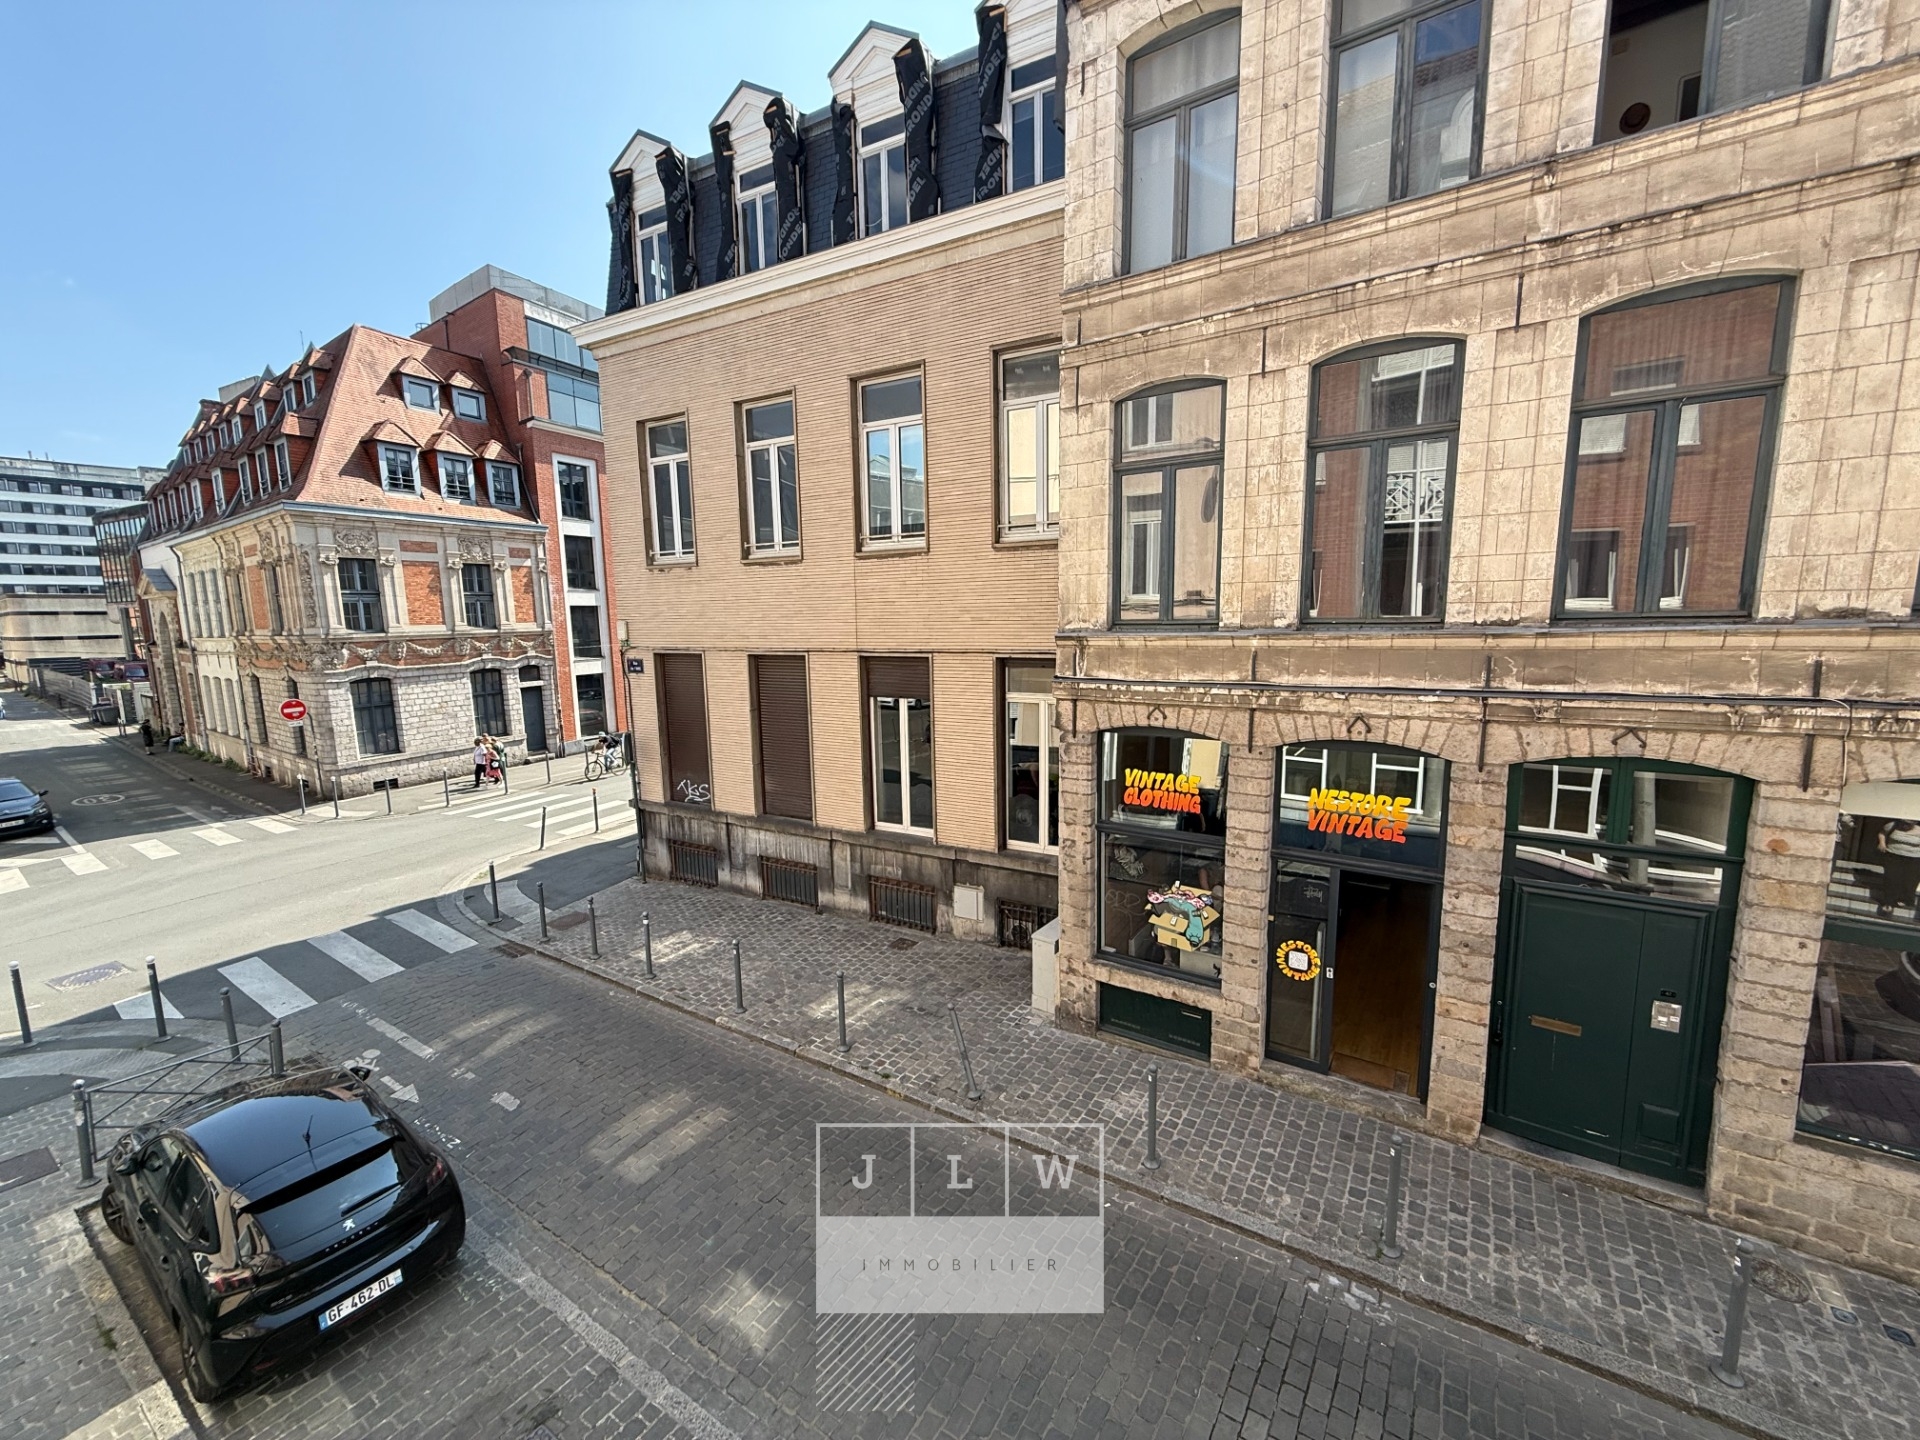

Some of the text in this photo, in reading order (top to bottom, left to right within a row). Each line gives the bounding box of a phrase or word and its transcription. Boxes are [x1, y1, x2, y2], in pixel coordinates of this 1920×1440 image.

[1125, 767, 1201, 795] VINTAGE
[1123, 786, 1201, 814] CLOTHING
[1308, 787, 1412, 822] NESTORE
[1308, 809, 1409, 844] VINTAGE
[1276, 940, 1321, 966] NESTORE
[1276, 957, 1320, 981] VINTAGE
[327, 1276, 395, 1323] GF-462-DL
